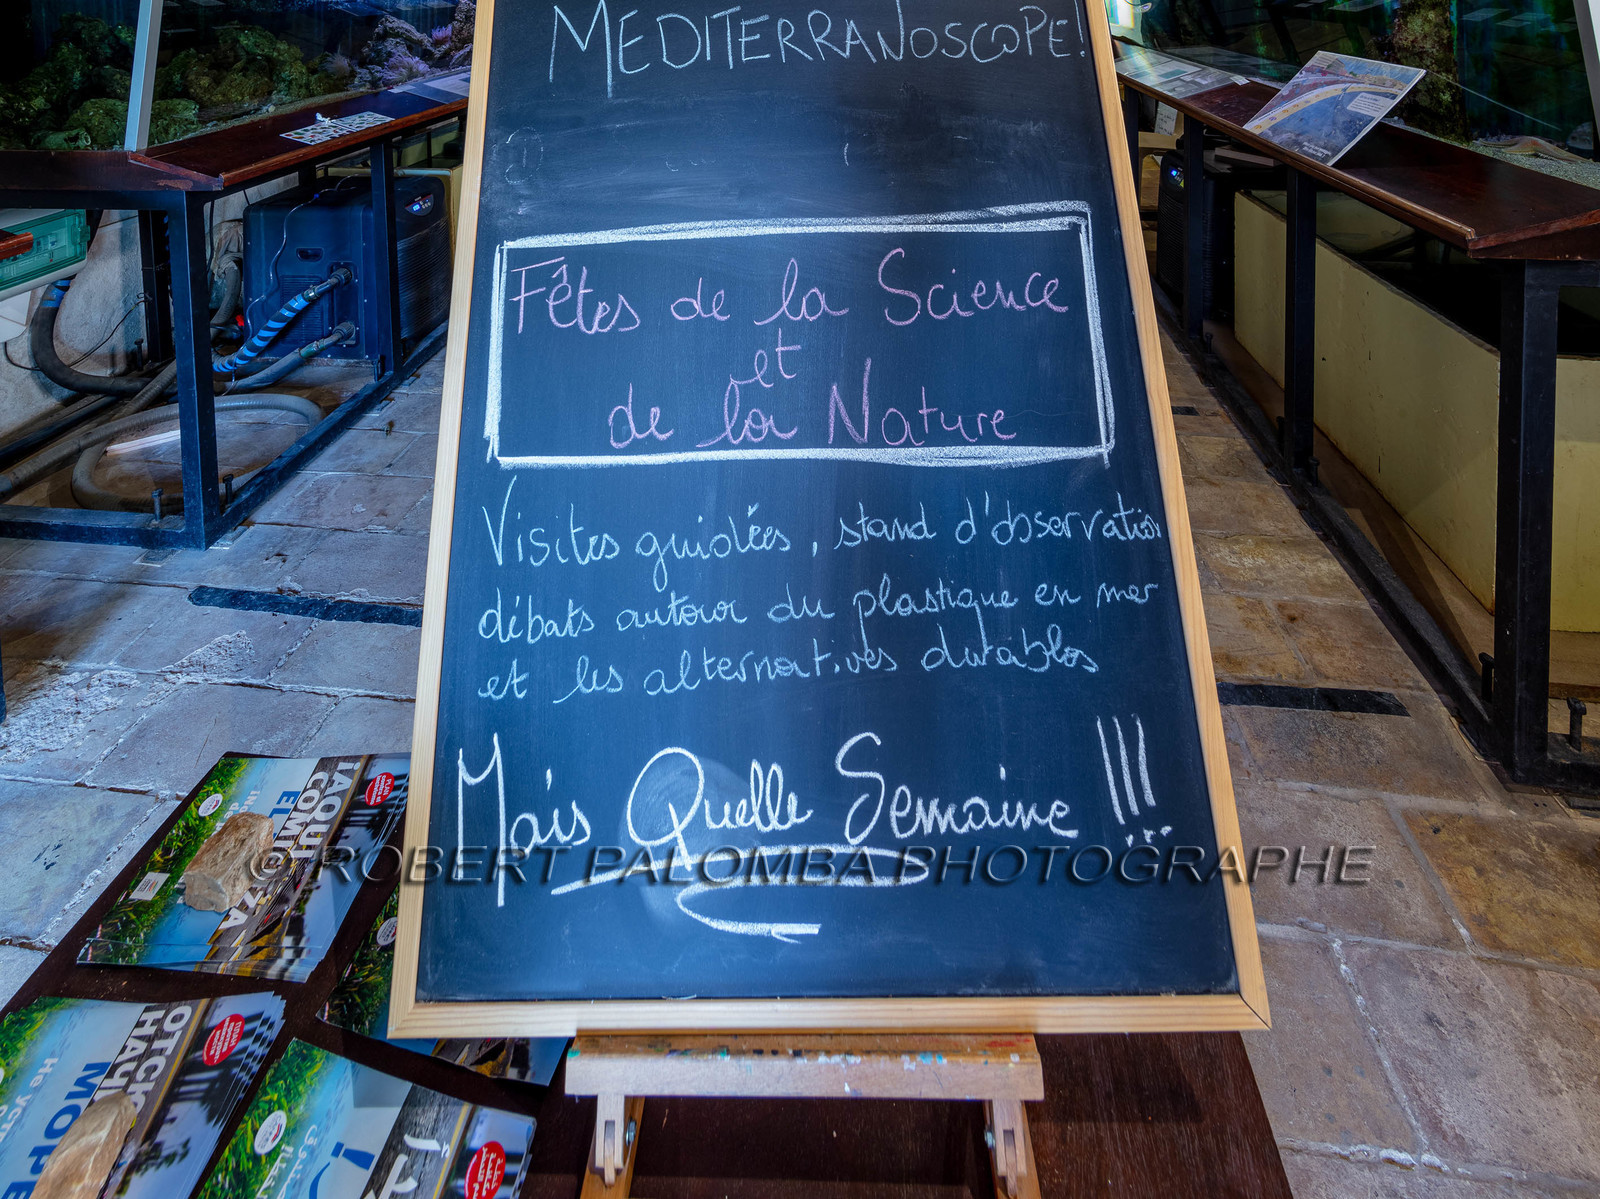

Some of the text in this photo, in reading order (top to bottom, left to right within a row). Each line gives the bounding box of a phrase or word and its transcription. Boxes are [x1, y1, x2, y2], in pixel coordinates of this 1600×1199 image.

[510, 246, 1069, 334] Fêtes de la Science
[730, 327, 802, 388] et
[607, 357, 1017, 449] de la Nature
[482, 475, 620, 567] Visites
[833, 501, 937, 550] stand
[478, 572, 1158, 657] débats autour du plastique en mer
[478, 623, 1099, 703] et les alternatives durables
[457, 731, 592, 907] Mais
[626, 746, 814, 872] Quelle
[834, 731, 1079, 845] Semaine
